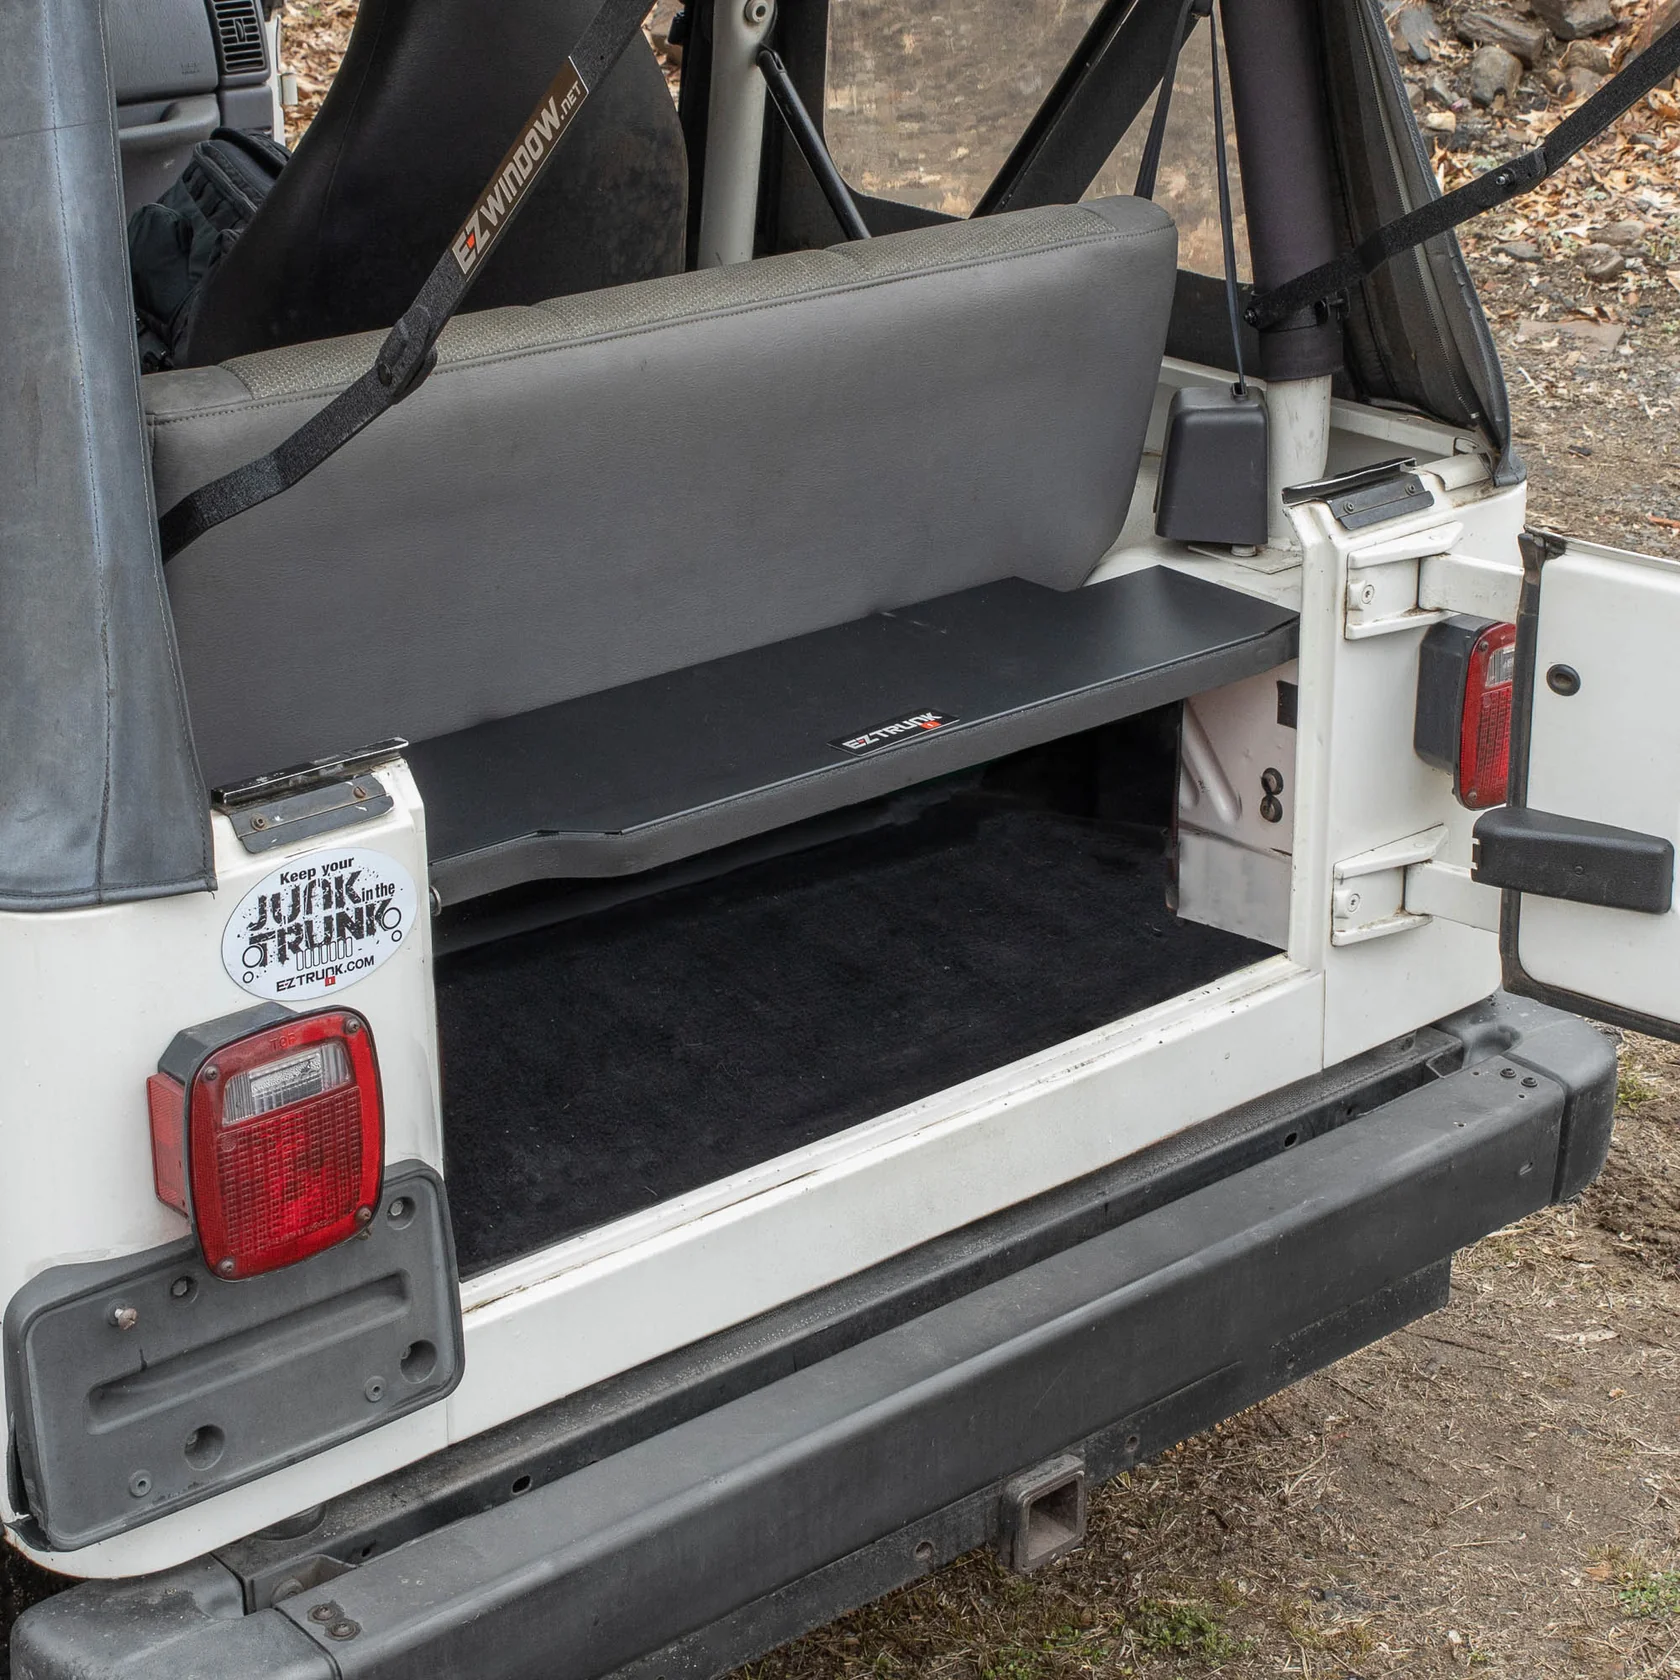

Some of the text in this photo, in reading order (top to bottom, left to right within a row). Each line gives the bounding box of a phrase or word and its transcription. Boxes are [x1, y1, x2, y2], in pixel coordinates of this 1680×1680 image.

[280, 857, 355, 886] Keep your
[247, 869, 362, 932] JUNK
[361, 882, 395, 901] in the
[248, 897, 393, 968] TRUNK
[270, 1032, 296, 1051] TOP
